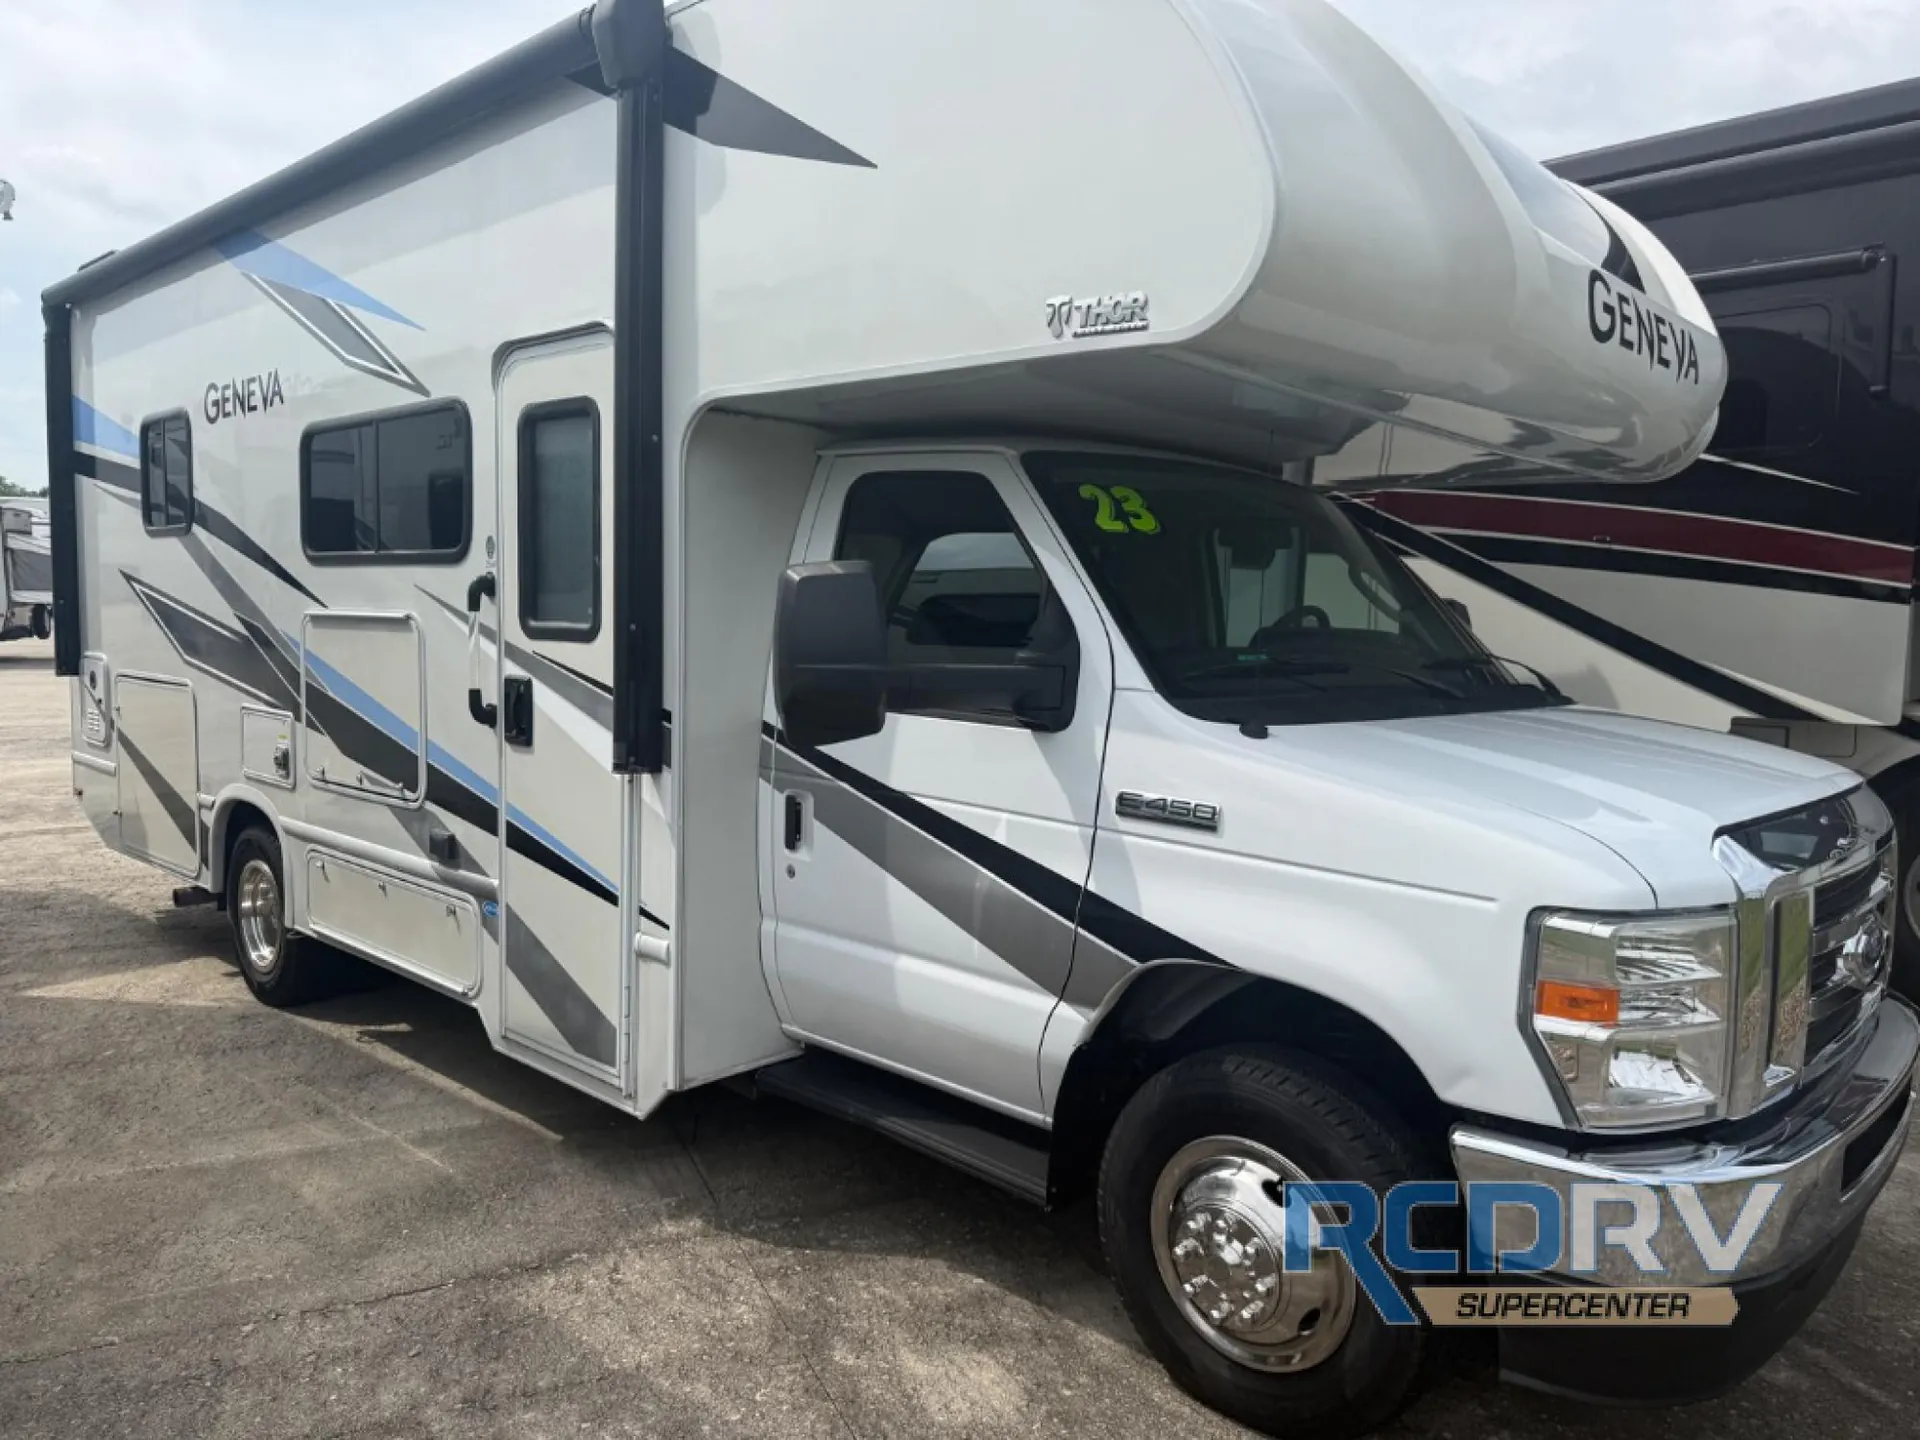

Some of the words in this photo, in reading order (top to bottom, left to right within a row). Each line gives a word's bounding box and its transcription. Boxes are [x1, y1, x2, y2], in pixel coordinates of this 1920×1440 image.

[1073, 291, 1149, 328] THOR
[1588, 269, 1699, 385] GENEVA
[203, 368, 284, 425] GENEVA
[1078, 484, 1160, 535] 23
